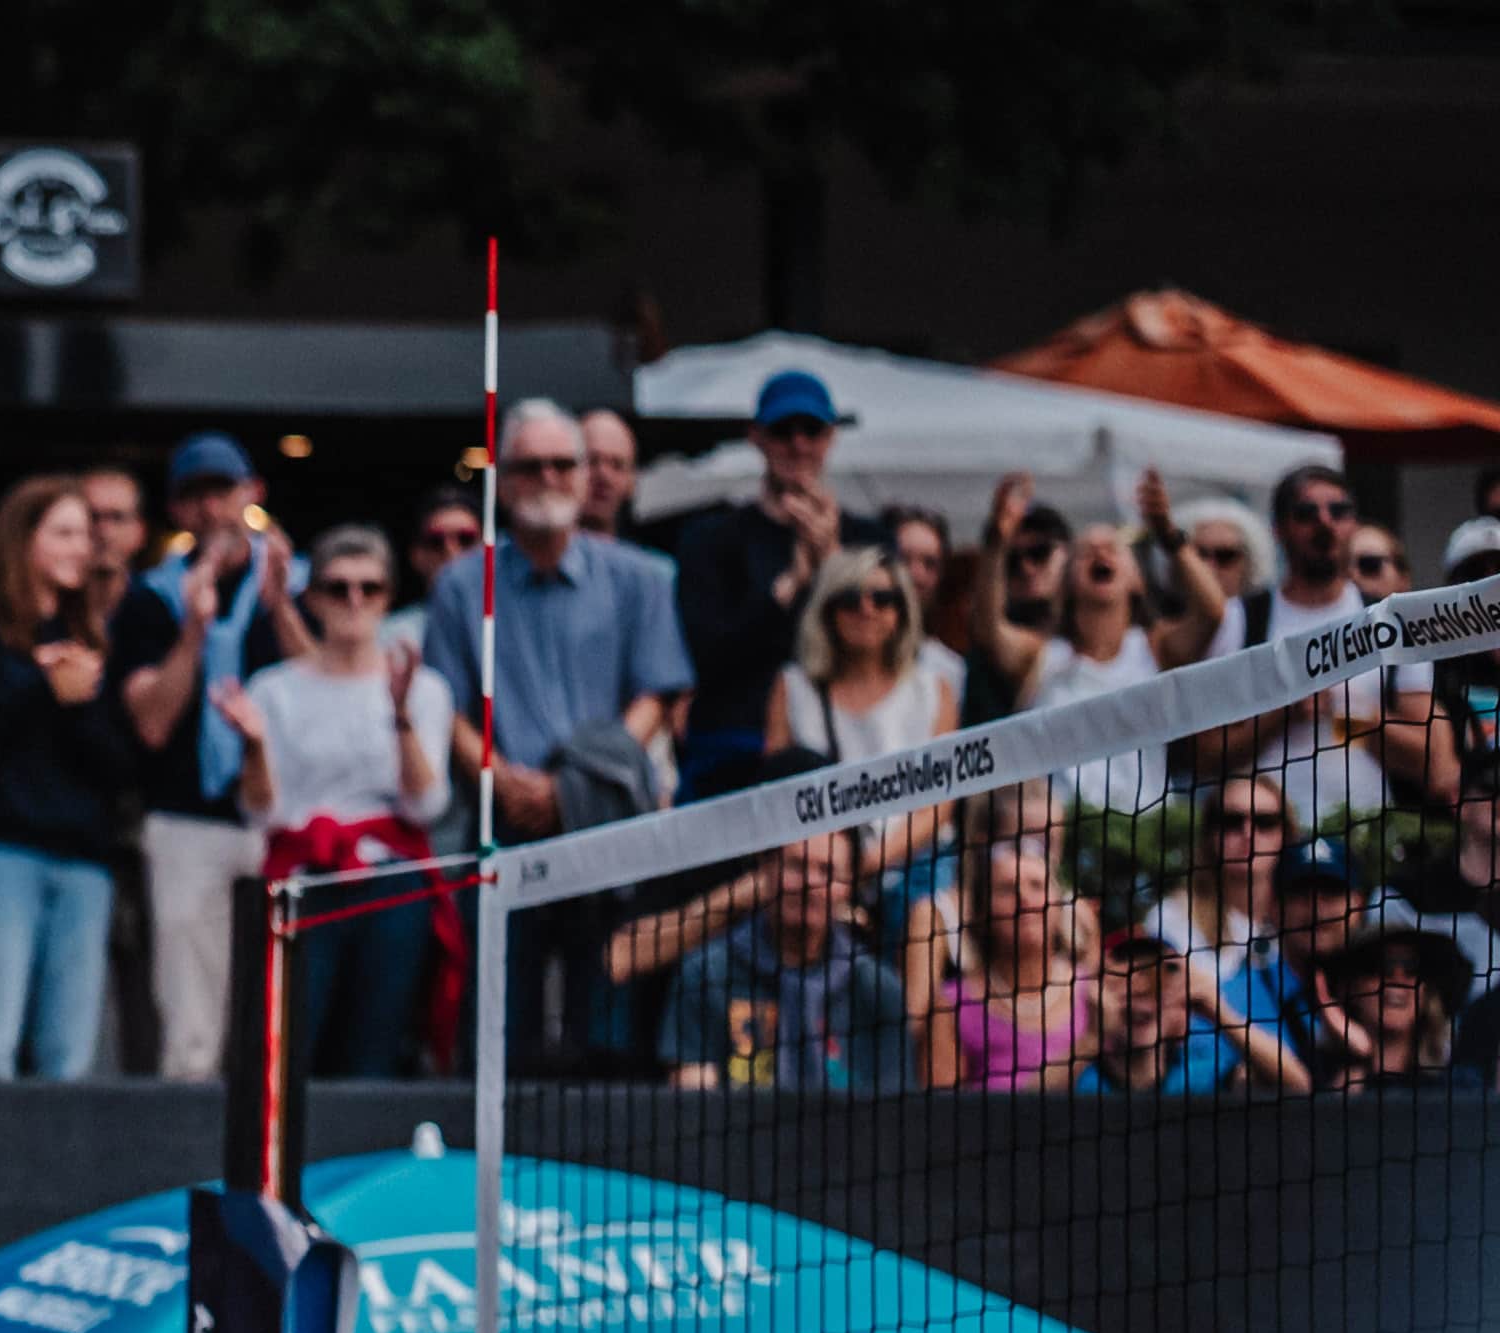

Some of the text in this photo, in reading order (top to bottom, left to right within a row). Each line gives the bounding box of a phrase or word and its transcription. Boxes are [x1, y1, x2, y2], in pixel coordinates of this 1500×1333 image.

[1306, 628, 1340, 679] CEV
[795, 736, 995, 824] CEV EuroBeachVolley 2025
